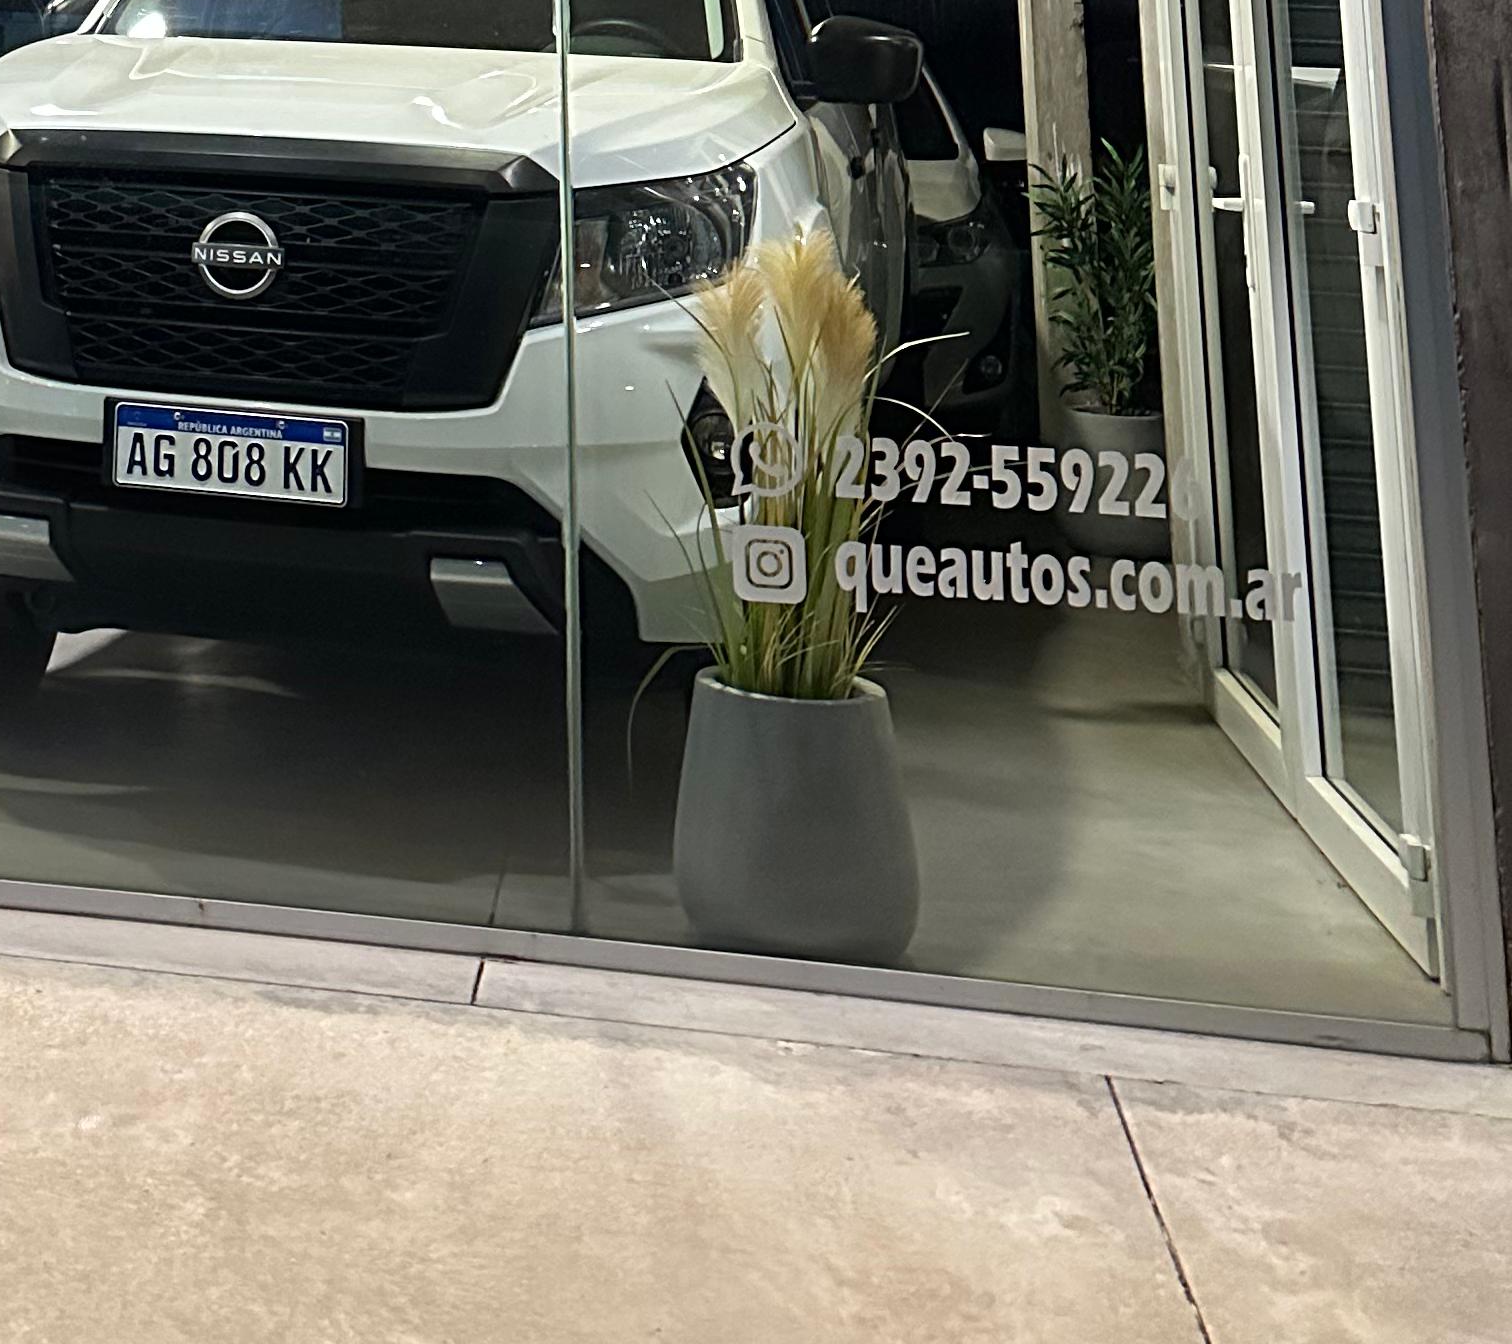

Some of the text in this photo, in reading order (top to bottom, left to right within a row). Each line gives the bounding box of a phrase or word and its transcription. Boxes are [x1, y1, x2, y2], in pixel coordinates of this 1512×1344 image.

[193, 246, 282, 266] NISSAN
[177, 419, 283, 440] REPÚBLICA ARGENTINA
[126, 432, 333, 494] AG 808 KK
[834, 540, 1302, 621] queautos.com.ar
